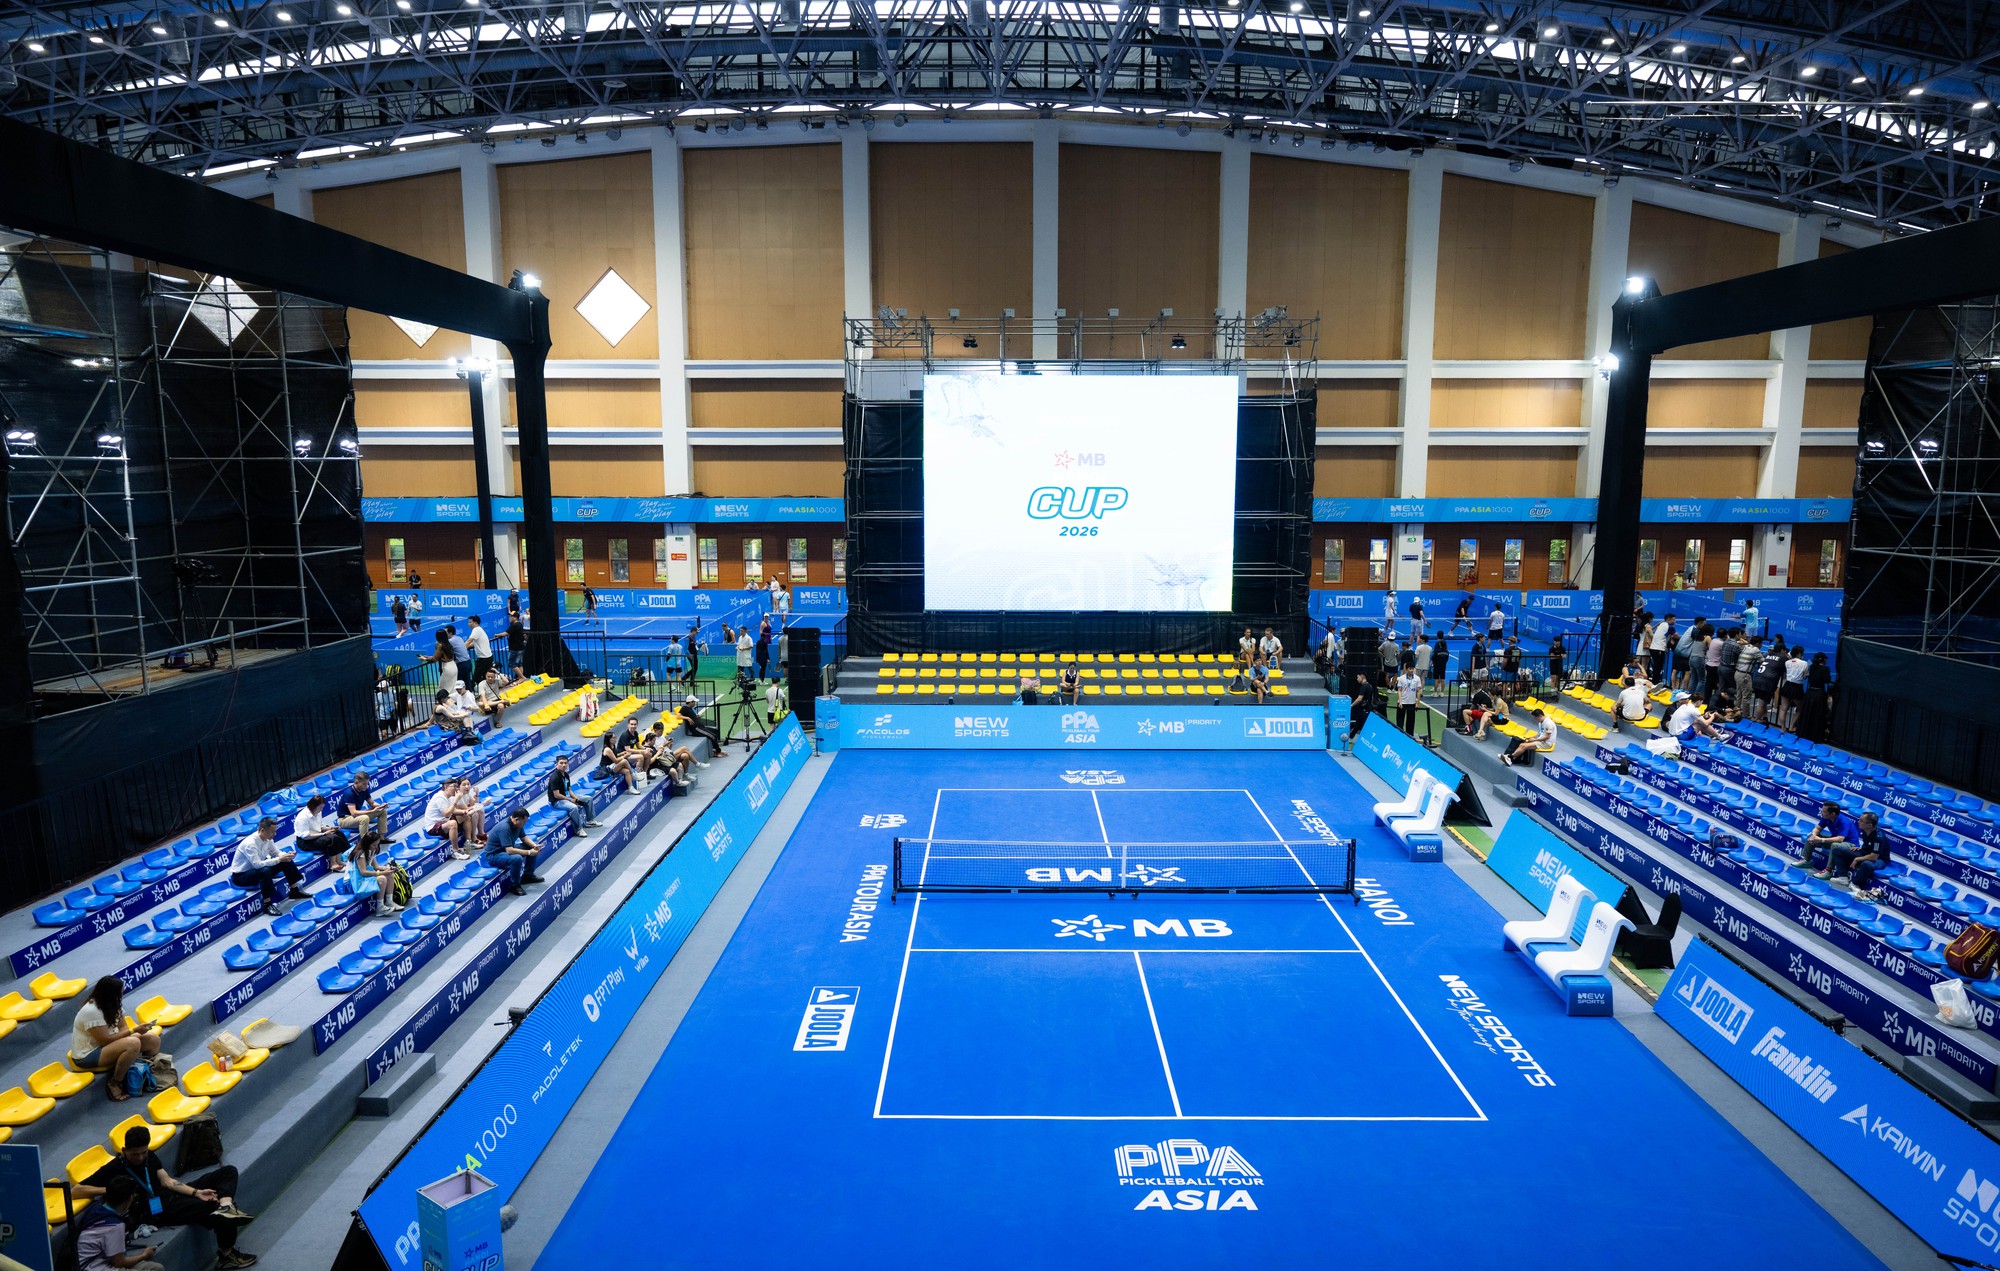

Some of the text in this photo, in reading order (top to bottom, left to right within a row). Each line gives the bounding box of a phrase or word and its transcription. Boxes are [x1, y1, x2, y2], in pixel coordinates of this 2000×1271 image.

[1077, 453, 1106, 466] MB
[1027, 486, 1128, 520] CUP
[576, 508, 598, 516] CUP
[1528, 507, 1552, 517] CUP
[1807, 508, 1830, 517] CUP
[1059, 526, 1099, 537] 2026
[442, 596, 467, 606] JOOLA
[487, 594, 504, 603] PPA
[651, 596, 675, 606] JOOLA
[695, 594, 711, 603] PPA
[1338, 598, 1361, 606] JOOLA
[1544, 598, 1568, 606] JOOLA
[1797, 595, 1814, 603] PPA
[1758, 662, 1769, 674] 5
[954, 717, 1009, 728] NEW
[1062, 711, 1100, 728] PPA
[1159, 721, 1184, 734] MB
[1268, 721, 1311, 734] JOOLA
[1064, 734, 1096, 743] ASIA
[1775, 752, 1786, 762] MB
[1811, 764, 1822, 775] MB
[1060, 775, 1126, 785] PPA
[1850, 779, 1863, 790] MB
[1581, 782, 1592, 796] MB
[1291, 800, 1317, 816] NEW
[1786, 794, 1798, 806] MB
[1892, 795, 1906, 808] MB
[1616, 802, 1628, 818] MB
[1718, 808, 1730, 820] MB
[859, 814, 875, 827] ASIA
[879, 814, 908, 828] PPA
[1564, 814, 1577, 832] MB
[1940, 814, 1955, 827] MB
[704, 817, 726, 851] NEW
[1656, 825, 1668, 841] MB
[1755, 826, 1766, 839] MB
[598, 845, 608, 865] MB
[712, 835, 733, 862] SPORTS
[1610, 843, 1624, 862] MB
[214, 853, 230, 869] MB
[1535, 848, 1572, 877] NEW
[1919, 851, 1933, 865] MB
[1025, 867, 1112, 882] MB
[1528, 866, 1558, 892] SPORT
[1973, 875, 1990, 890] MB
[164, 880, 180, 896] MB
[489, 882, 501, 902] MB
[562, 878, 573, 901] MB
[1752, 880, 1769, 899] MB
[654, 876, 681, 928] MB PRIORITY
[1354, 878, 1414, 926] HANOI
[1888, 891, 1904, 907] MB
[106, 906, 125, 926] MB
[335, 917, 349, 934] MB
[446, 916, 461, 938] MB
[517, 920, 531, 946] MB
[1132, 919, 1233, 937] MB
[1813, 913, 1860, 940] MB PRIORITY
[1945, 920, 1962, 936] MB
[195, 928, 211, 946] MB
[1729, 920, 1779, 948] MB PRIORITY
[41, 938, 62, 959] MB
[290, 949, 304, 967] MB
[135, 961, 153, 981] MB
[396, 956, 412, 979] MB
[1883, 952, 1939, 983] MB PRIORITY
[462, 970, 479, 1000] MB
[594, 966, 626, 1006] FPT Play
[1807, 964, 1869, 1004] MB PRIORITY
[237, 982, 254, 1003] MB
[336, 981, 376, 1030] MB PRIORITY
[1695, 986, 1748, 1038] JOOLA
[416, 1002, 439, 1032] PRIORITY
[802, 1006, 846, 1048] JOOLA
[1438, 974, 1556, 1086] NEW SPORTS
[1941, 1042, 1984, 1075] PRIORITY
[531, 1034, 583, 1104] PADDLETEK
[1114, 1138, 1262, 1176] PPA
[1870, 1116, 1946, 1182] KAIWIN
[1119, 1178, 1264, 1186] PICKLEBALL TOUR
[1133, 1190, 1259, 1210] ASIA
[475, 1242, 488, 1253] MB
